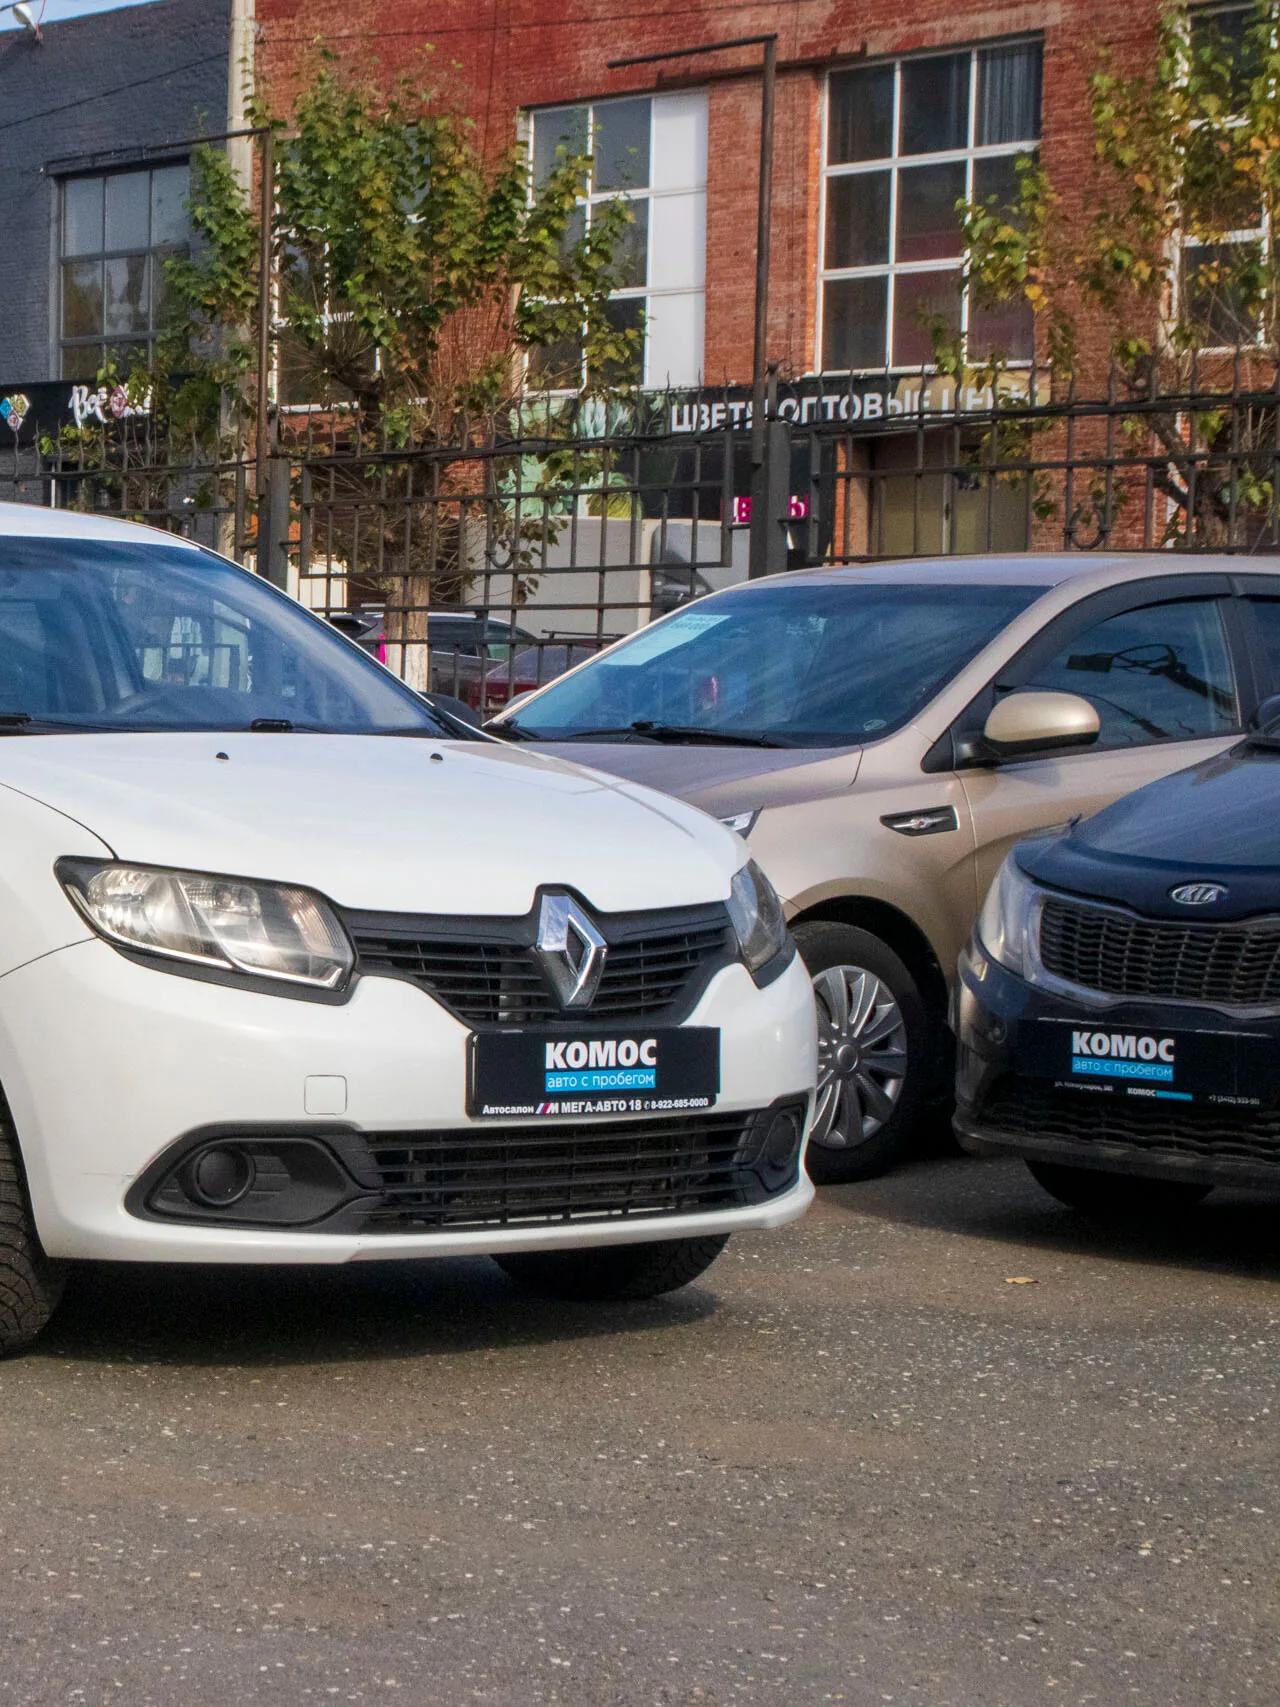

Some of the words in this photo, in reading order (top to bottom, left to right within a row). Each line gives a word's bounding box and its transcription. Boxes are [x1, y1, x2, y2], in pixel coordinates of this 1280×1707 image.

[778, 390, 931, 425] ОПТОВЫЕ
[1177, 886, 1220, 903] KIA
[545, 1039, 658, 1070] КОМОС
[1072, 1031, 1176, 1063] КОМОС
[1074, 1061, 1100, 1072] авто
[1105, 1063, 1111, 1072] с
[1114, 1063, 1172, 1078] пробегом
[548, 1075, 577, 1089] авто
[581, 1075, 589, 1087] с
[592, 1072, 656, 1089] пробегом
[1127, 1087, 1156, 1097] КОМОС
[482, 1104, 535, 1115] Автосалон
[561, 1101, 626, 1114] МЕГА-АВТО
[628, 1099, 641, 1111] 18
[651, 1097, 709, 1110] 8-922-685-0000
